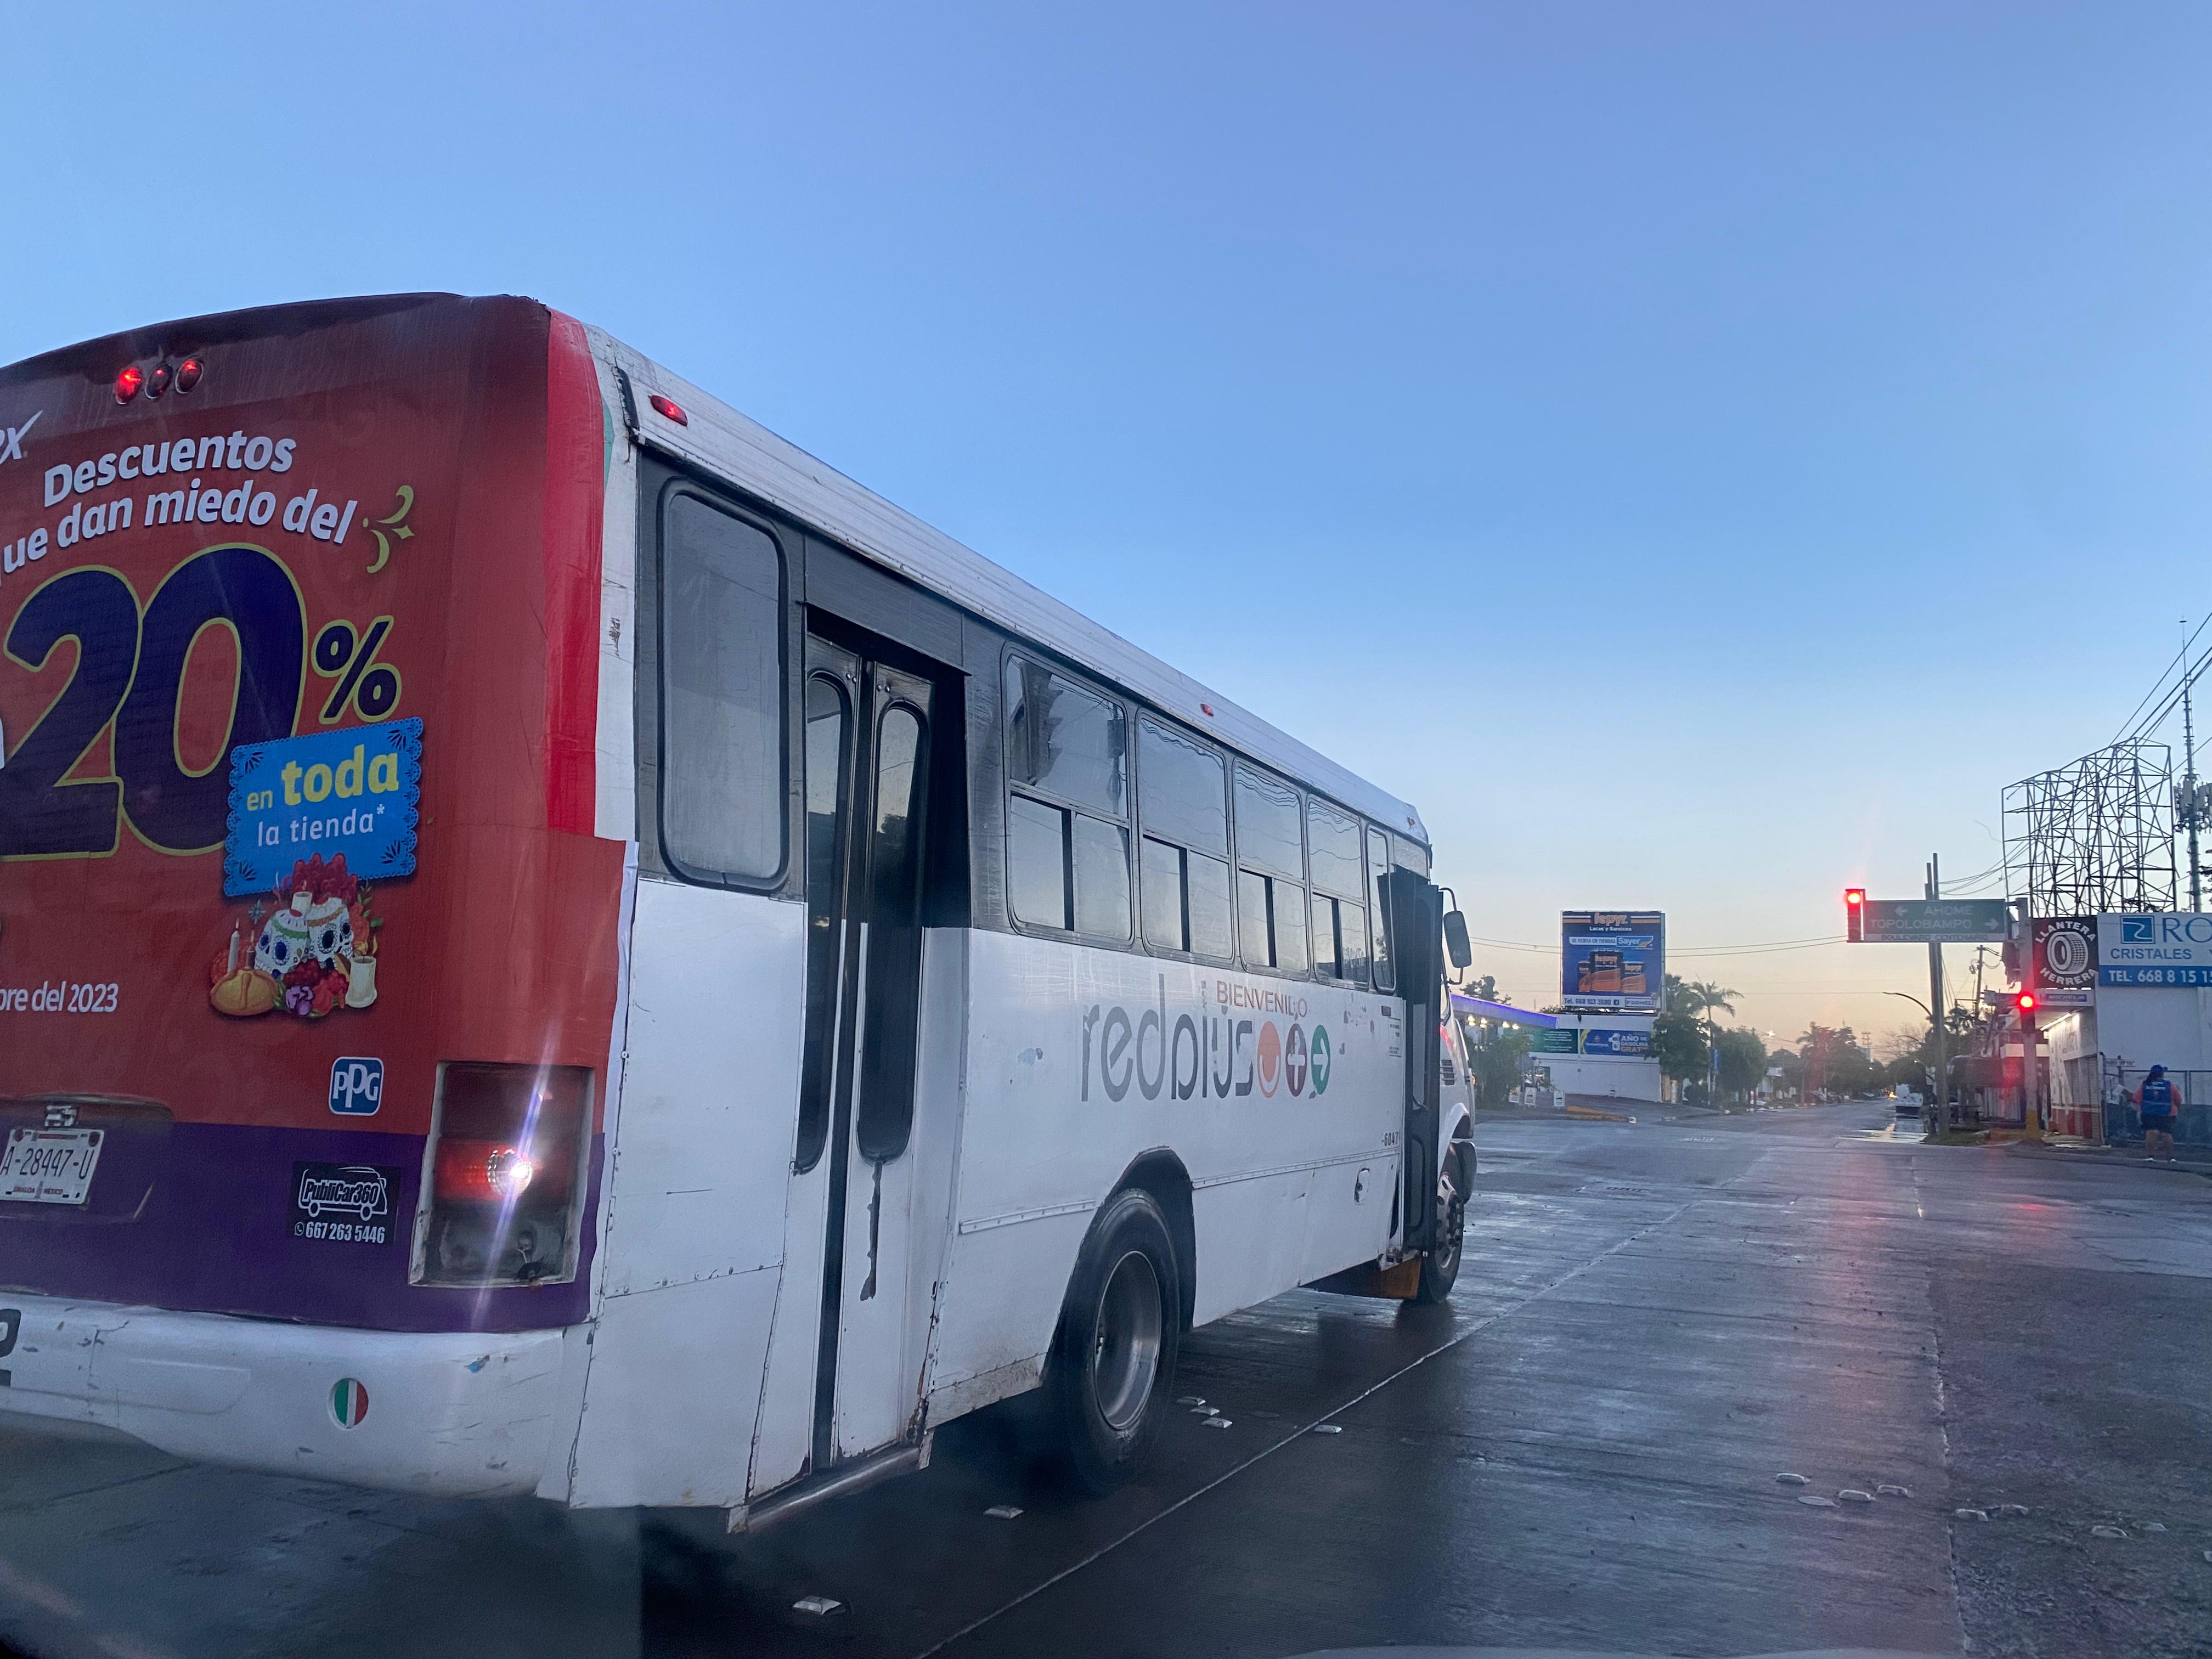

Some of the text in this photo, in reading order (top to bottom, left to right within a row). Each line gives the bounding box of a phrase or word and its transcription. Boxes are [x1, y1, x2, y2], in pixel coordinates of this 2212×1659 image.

[44, 430, 296, 507] Descuentos
[4, 478, 358, 573] ue dan miedo del
[247, 744, 399, 811] en toda
[257, 821, 279, 847] la
[1925, 906, 1974, 916] AHOME
[1870, 919, 1972, 929] TOPOLOBAMPO
[2035, 921, 2096, 944] LLANTERA
[1618, 937, 1641, 946] Sayer
[2111, 948, 2192, 960] CRISTALES
[2040, 967, 2099, 985] HERRERA
[2137, 970, 2163, 983] 668
[2168, 970, 2175, 983] 8
[2181, 970, 2197, 983] 15
[31, 981, 66, 1011] del
[67, 983, 119, 1012] 2023
[332, 1063, 380, 1108] PPG
[0, 1146, 95, 1180] A-28447-U
[302, 1179, 380, 1206] PubliCar360
[306, 1222, 385, 1244] 667 263 5446
